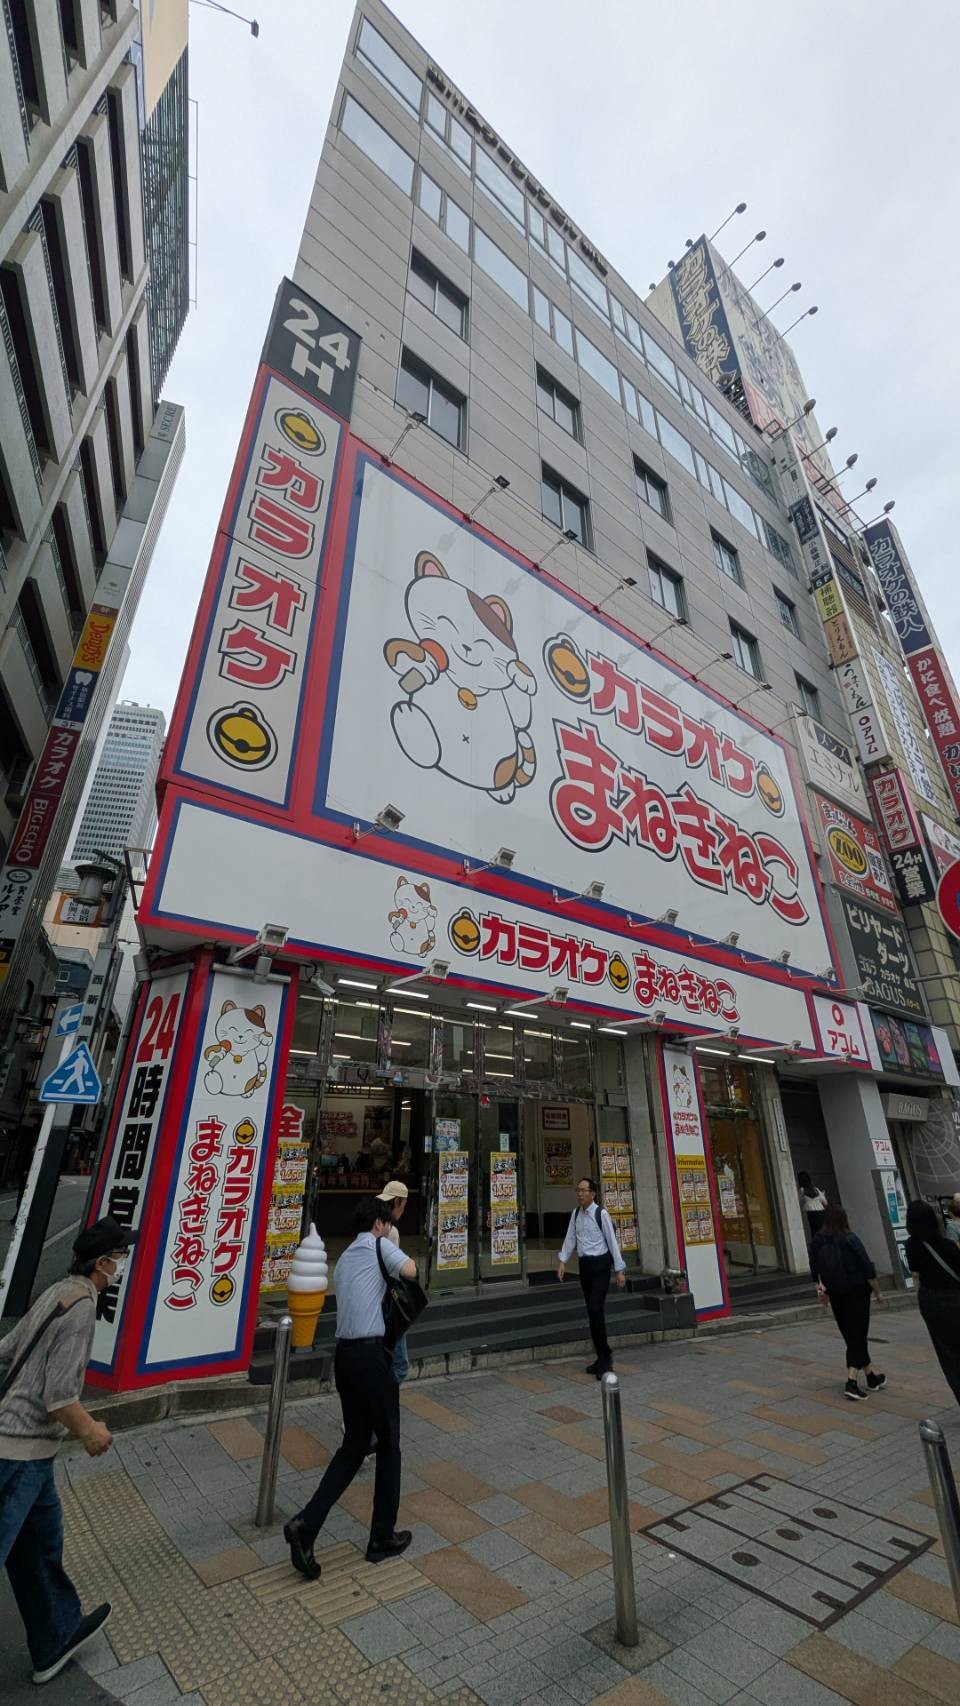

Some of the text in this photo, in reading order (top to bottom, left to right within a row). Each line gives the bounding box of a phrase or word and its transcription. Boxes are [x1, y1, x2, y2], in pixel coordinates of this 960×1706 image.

[283, 298, 351, 371] 24
[290, 342, 337, 396] H
[219, 443, 326, 690] カラオケ
[870, 537, 924, 639] カラオケの鉄人
[82, 621, 110, 664] Denny's
[587, 649, 756, 797] カラオケ
[916, 657, 957, 738] かに食べ放題
[39, 732, 75, 790] カラオケ
[808, 745, 859, 792] エミナル
[550, 718, 809, 925] まねきねこ
[875, 778, 910, 845] カラオケ
[893, 853, 923, 870] 24H
[902, 866, 927, 899] 営業
[846, 903, 902, 948] ビリヤード
[479, 911, 740, 1023] カラオケ まねきねこ
[877, 941, 908, 974] ダーツ
[827, 1029, 860, 1056] アコム
[873, 1140, 891, 1153] アコム
[164, 1115, 229, 1311] まねきねこ
[211, 1145, 258, 1277] カラオケ
